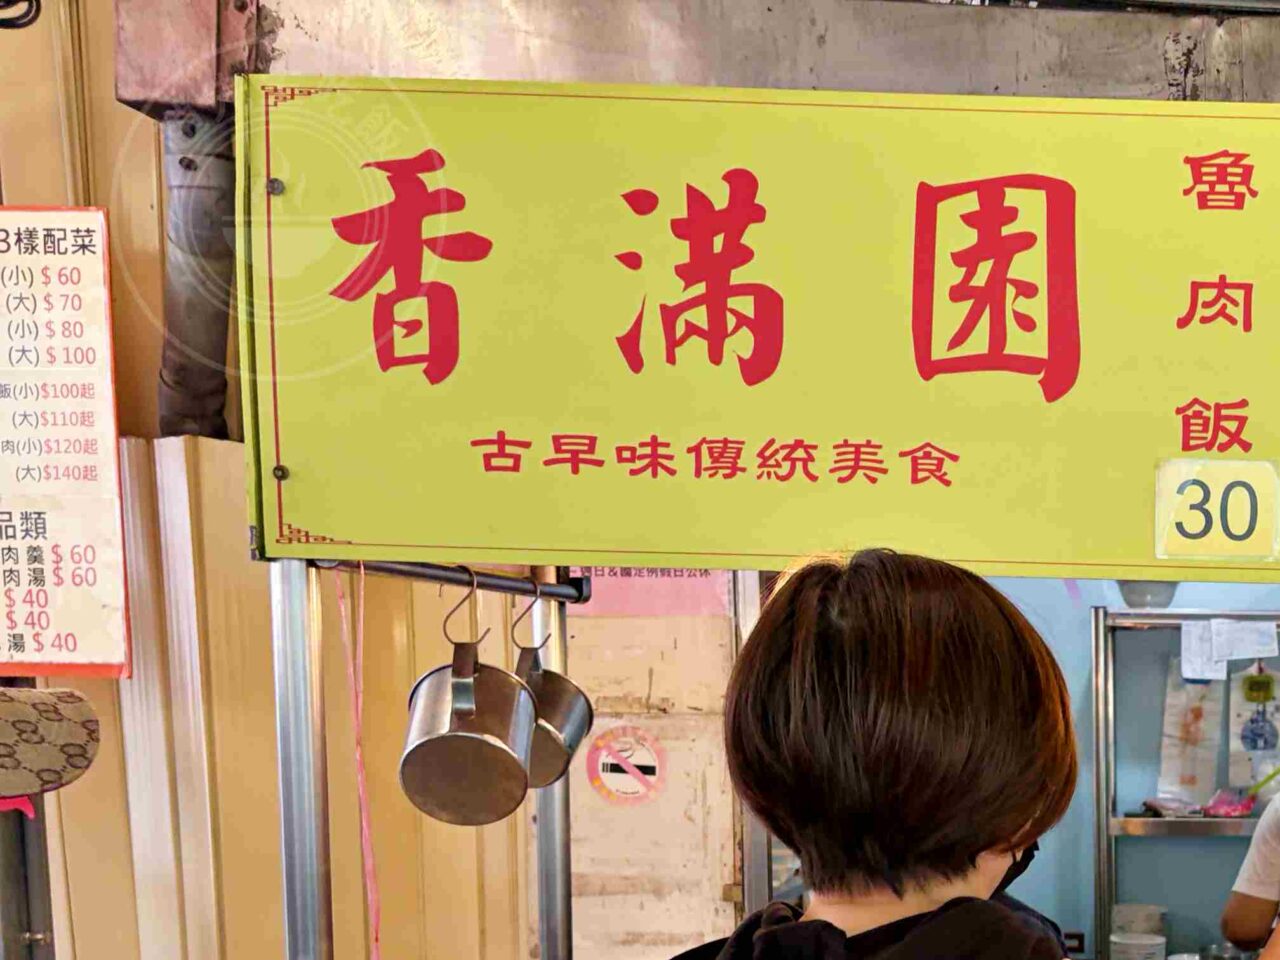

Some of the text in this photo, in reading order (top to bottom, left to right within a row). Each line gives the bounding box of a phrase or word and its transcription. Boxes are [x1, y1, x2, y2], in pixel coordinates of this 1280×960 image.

[330, 148, 1081, 403] 香滿園
[1175, 149, 1259, 453] 魯肉飯
[470, 430, 960, 488] 古早味傳統美食
[1174, 478, 1259, 543] 30
